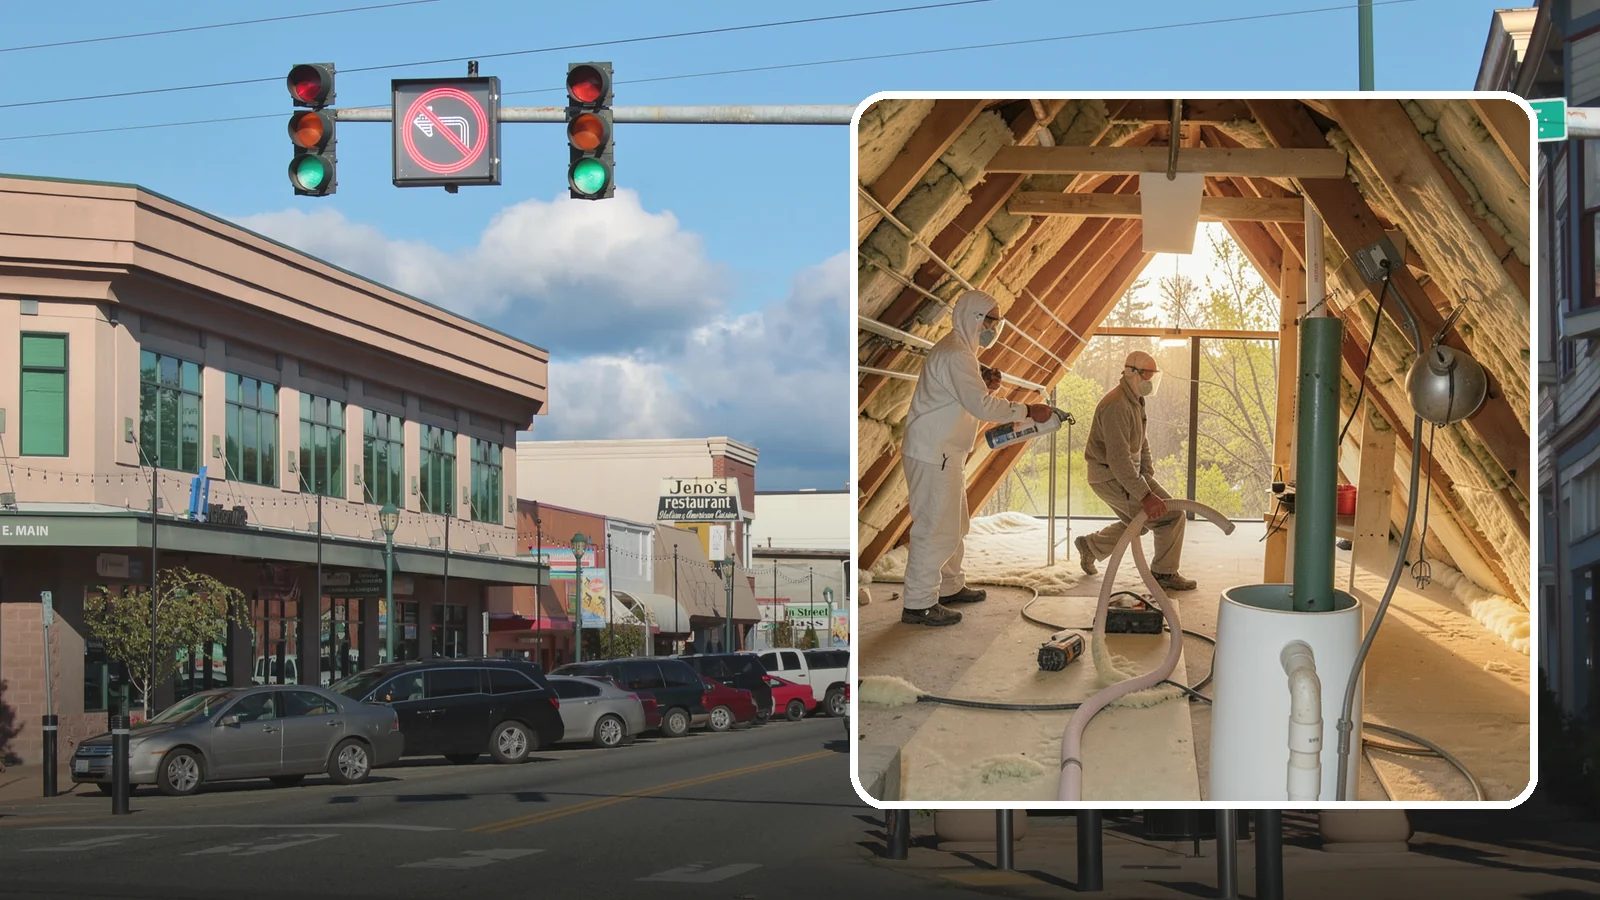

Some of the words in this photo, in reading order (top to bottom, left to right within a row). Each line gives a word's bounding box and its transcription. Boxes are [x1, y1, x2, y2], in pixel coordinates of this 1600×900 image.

[669, 479, 728, 495] Jeno's
[665, 496, 731, 509] restaurant
[658, 510, 681, 520] Italian
[686, 509, 714, 520] American
[714, 509, 738, 519] Cuisine
[2, 525, 13, 536] E.
[15, 525, 49, 537] MAIN
[797, 607, 828, 617] Street
